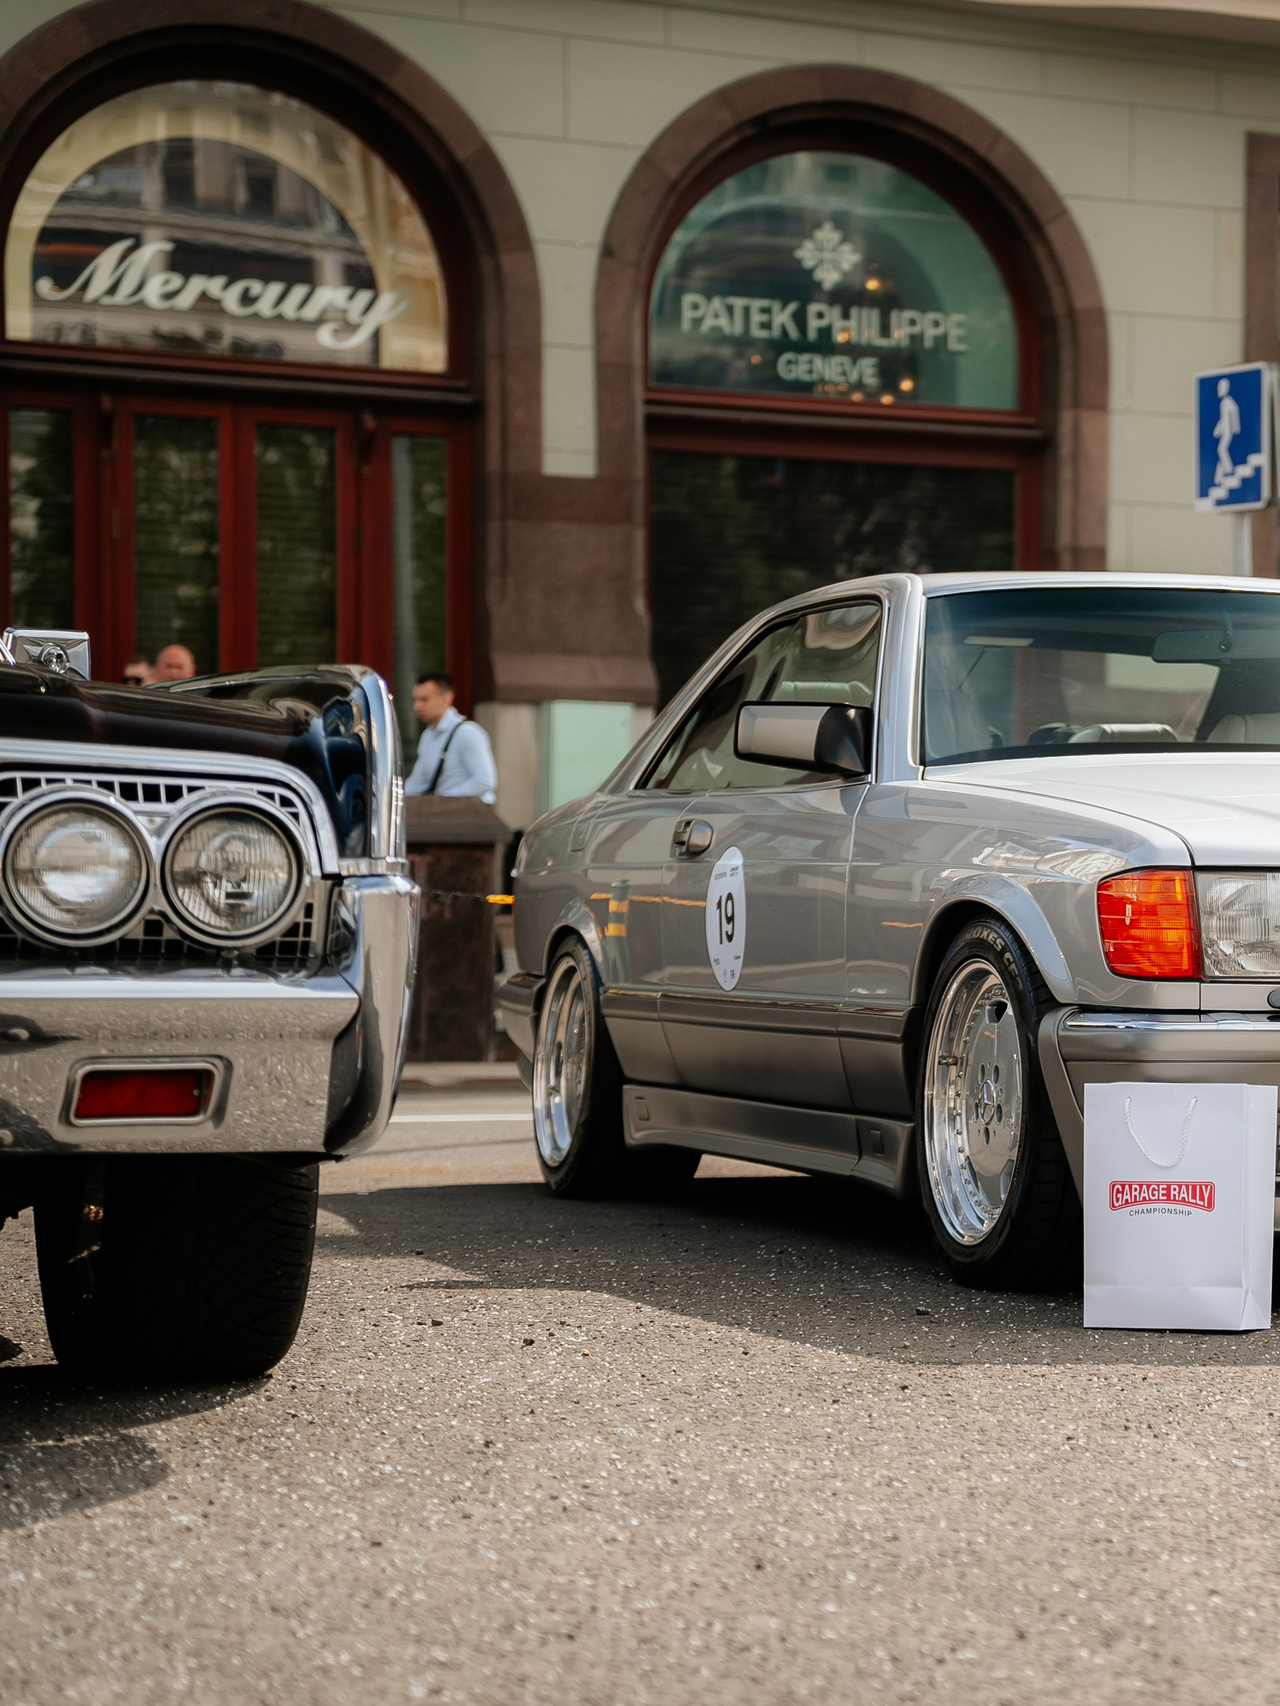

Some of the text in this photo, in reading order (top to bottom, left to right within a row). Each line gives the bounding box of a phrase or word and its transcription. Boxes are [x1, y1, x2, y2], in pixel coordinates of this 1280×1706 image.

[35, 237, 408, 350] Mercury
[680, 292, 969, 351] PATEK PHILIPPE
[716, 892, 735, 945] 19
[1113, 1184, 1211, 1207] GARAGE RALLY
[1128, 1207, 1192, 1217] CHAMPIONSHIP
